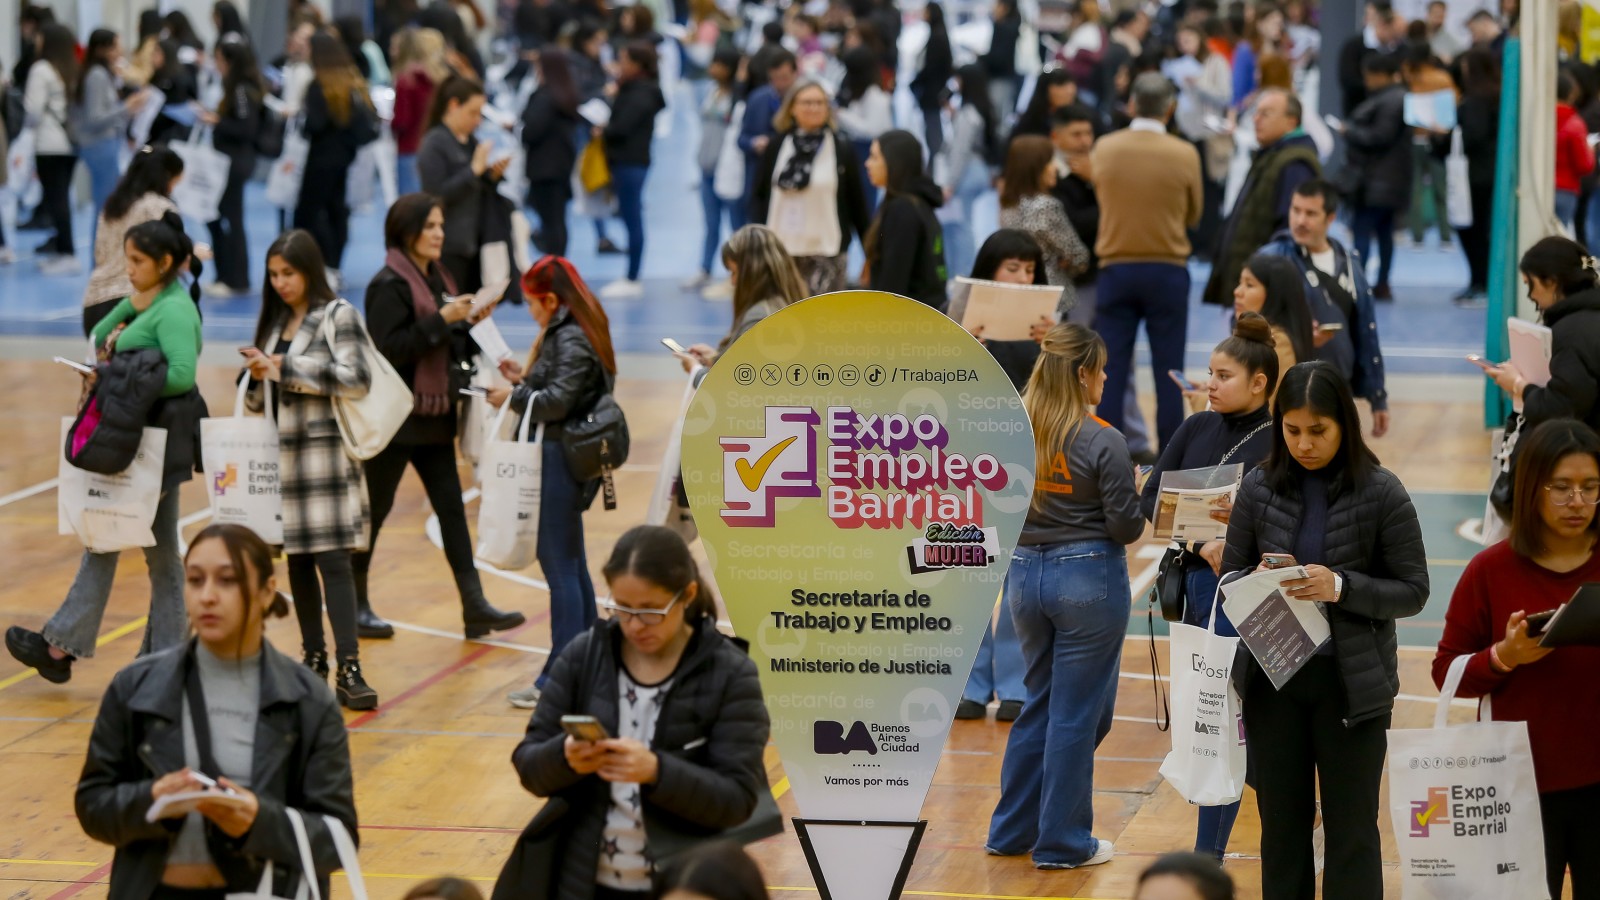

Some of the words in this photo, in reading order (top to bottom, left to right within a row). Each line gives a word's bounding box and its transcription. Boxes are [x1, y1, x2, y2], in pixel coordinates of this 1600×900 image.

[827, 406, 940, 447] Expo
[248, 460, 278, 471] Expo
[827, 446, 999, 487] Empleo
[827, 485, 974, 520] Barrial
[926, 523, 985, 544] Edición
[852, 544, 874, 560] de
[924, 545, 987, 567] MUJER
[728, 566, 793, 584] Trabajo
[814, 566, 874, 584] Empleo
[790, 588, 900, 608] Secretaría
[904, 589, 931, 608] de
[770, 611, 850, 633] Trabajo
[854, 615, 867, 634] y
[871, 612, 951, 633] Empleo
[902, 642, 964, 660] Empleo
[770, 658, 854, 674] Ministerio
[858, 658, 880, 675] de
[883, 659, 952, 675] Justicia
[768, 692, 847, 709] retaría
[853, 695, 875, 709] de
[871, 723, 910, 733] Buenos
[813, 720, 877, 755] BA
[877, 733, 907, 742] Aires
[881, 742, 920, 753] Ciudad
[824, 775, 861, 787] Vamos
[863, 777, 883, 789] por
[886, 776, 910, 787] más
[1451, 785, 1497, 801] Expo
[1452, 801, 1511, 820] Empleo
[1453, 817, 1508, 837] Barrial
